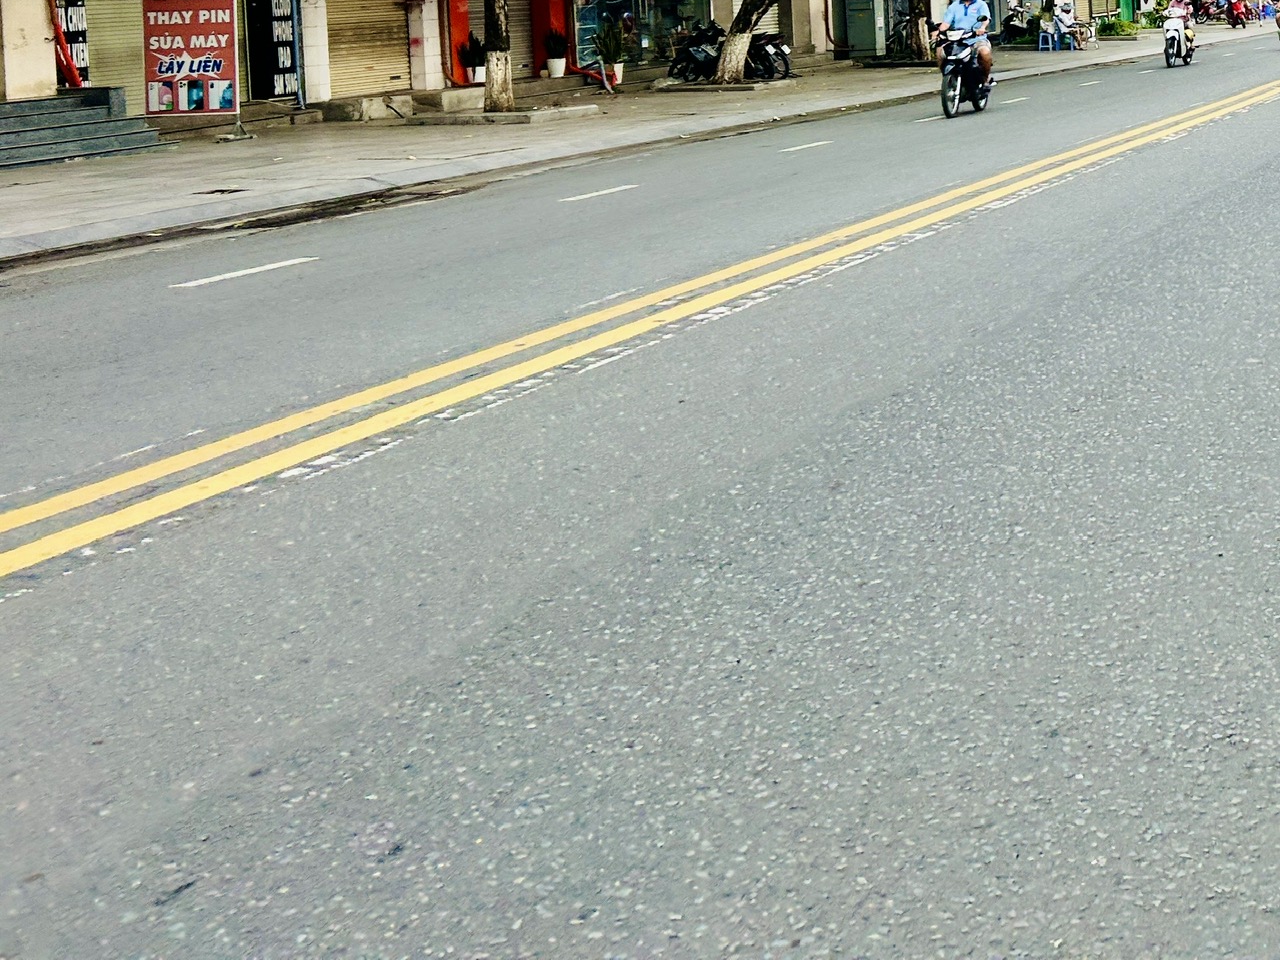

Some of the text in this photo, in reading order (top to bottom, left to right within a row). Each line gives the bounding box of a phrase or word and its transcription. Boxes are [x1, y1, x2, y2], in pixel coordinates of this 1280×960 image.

[147, 9, 231, 25] THAY PIN
[149, 31, 230, 50] SỬA MÁY
